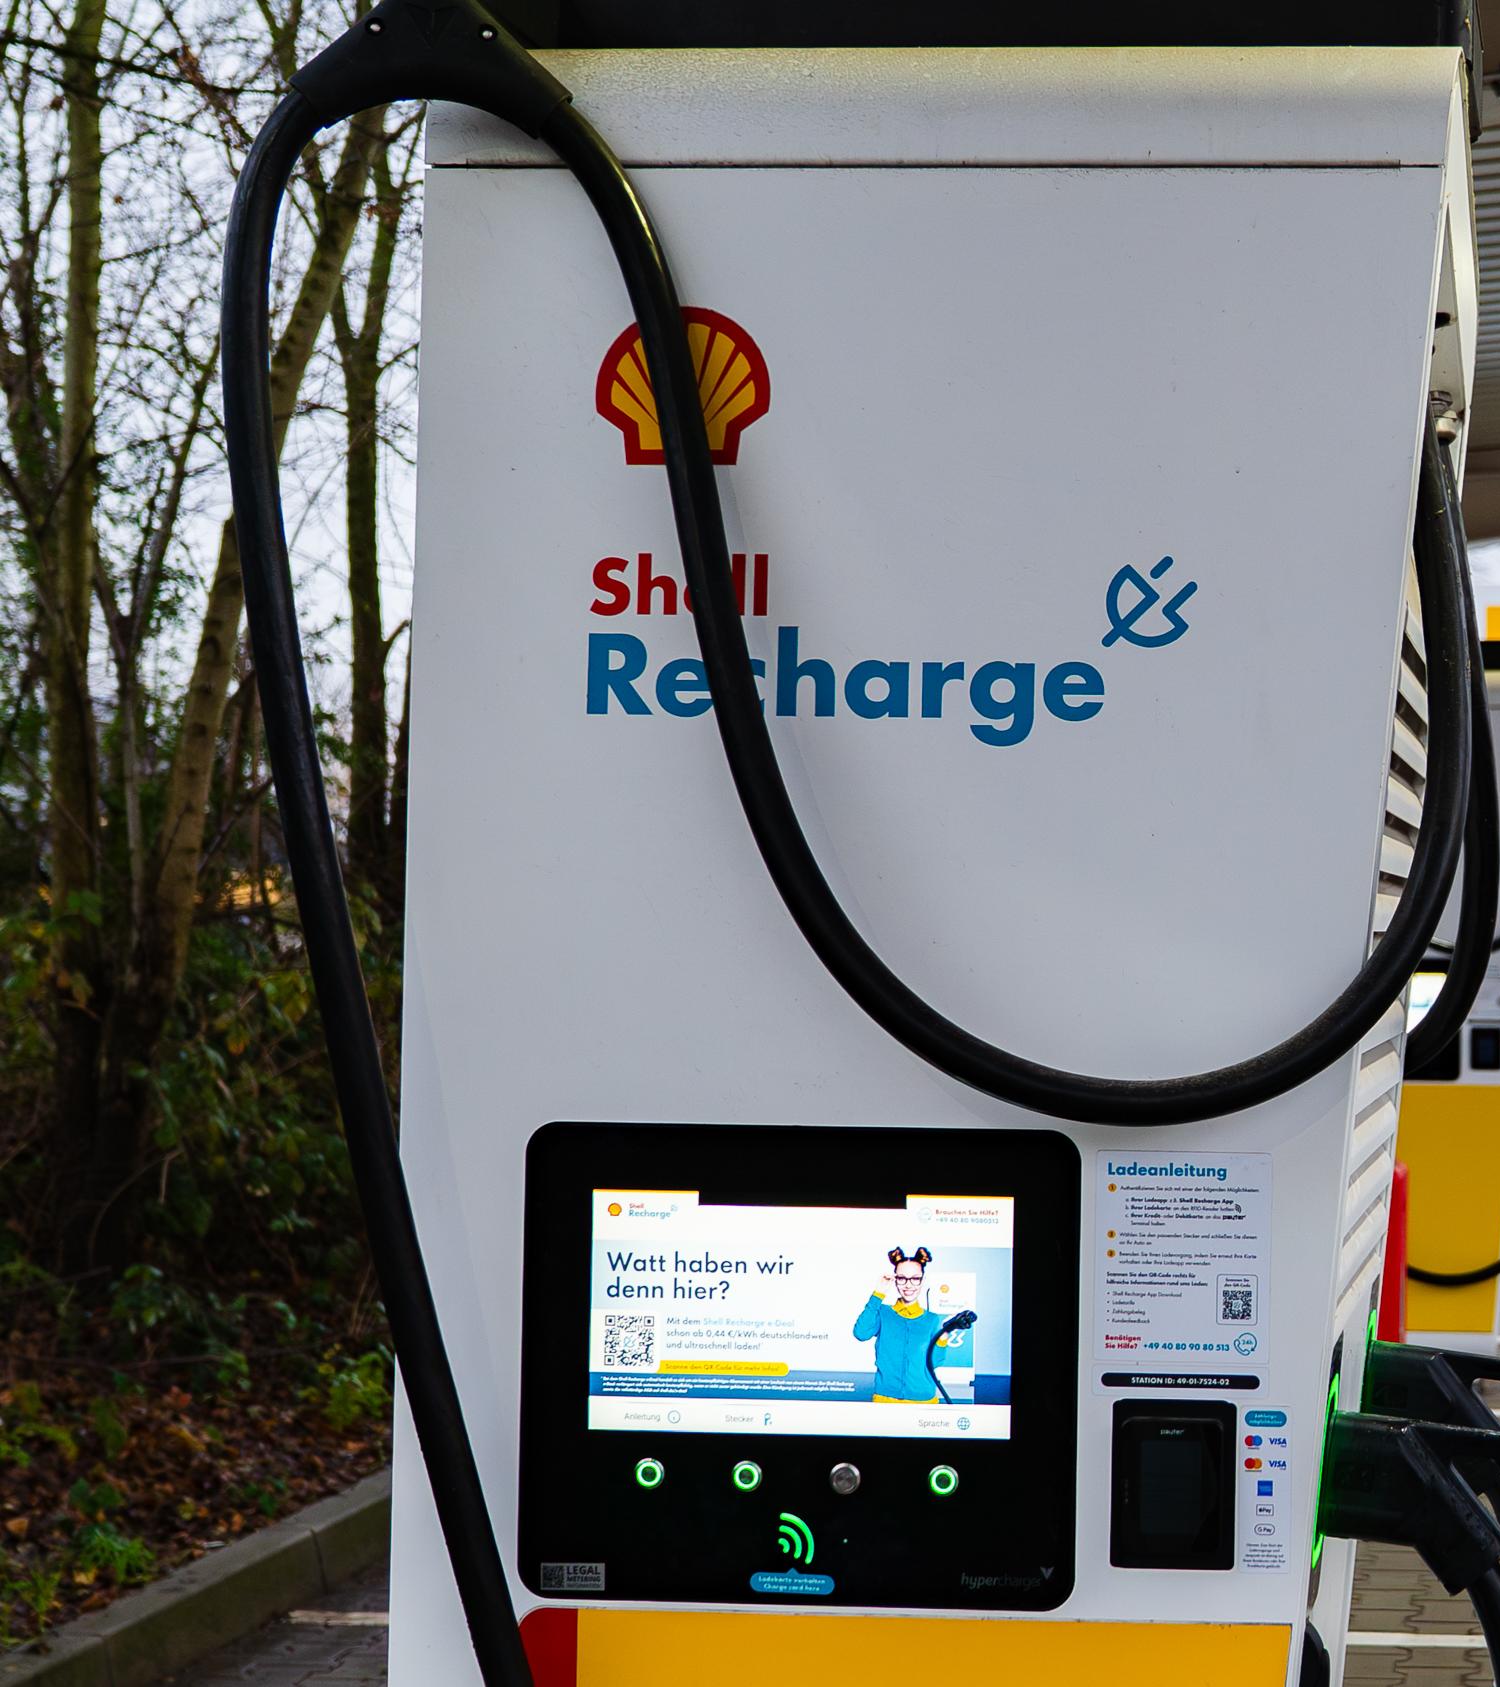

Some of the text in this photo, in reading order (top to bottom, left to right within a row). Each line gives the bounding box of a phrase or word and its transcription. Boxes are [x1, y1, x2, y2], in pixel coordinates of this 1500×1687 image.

[590, 552, 769, 617] Shll
[1108, 1162, 1228, 1180] Ladeanleitung
[628, 1210, 671, 1220] Recharge
[607, 1250, 794, 1275] Watt haben wir
[606, 1276, 730, 1300] denn hier?
[666, 1317, 680, 1325] Mit
[682, 1317, 701, 1326] dem
[666, 1328, 690, 1337] schon
[692, 1329, 704, 1338] ab
[706, 1329, 725, 1338] 0,44
[760, 1331, 828, 1340] deutschlandweit
[1105, 1334, 1142, 1343] Benötigen
[666, 1340, 682, 1349] und
[684, 1341, 732, 1350] ultraschnell
[1144, 1342, 1230, 1352] +49 40 80 90 80 513
[624, 1412, 951, 1428] Anleitung Stecker Sprache
[566, 1565, 600, 1575] LEGAL
